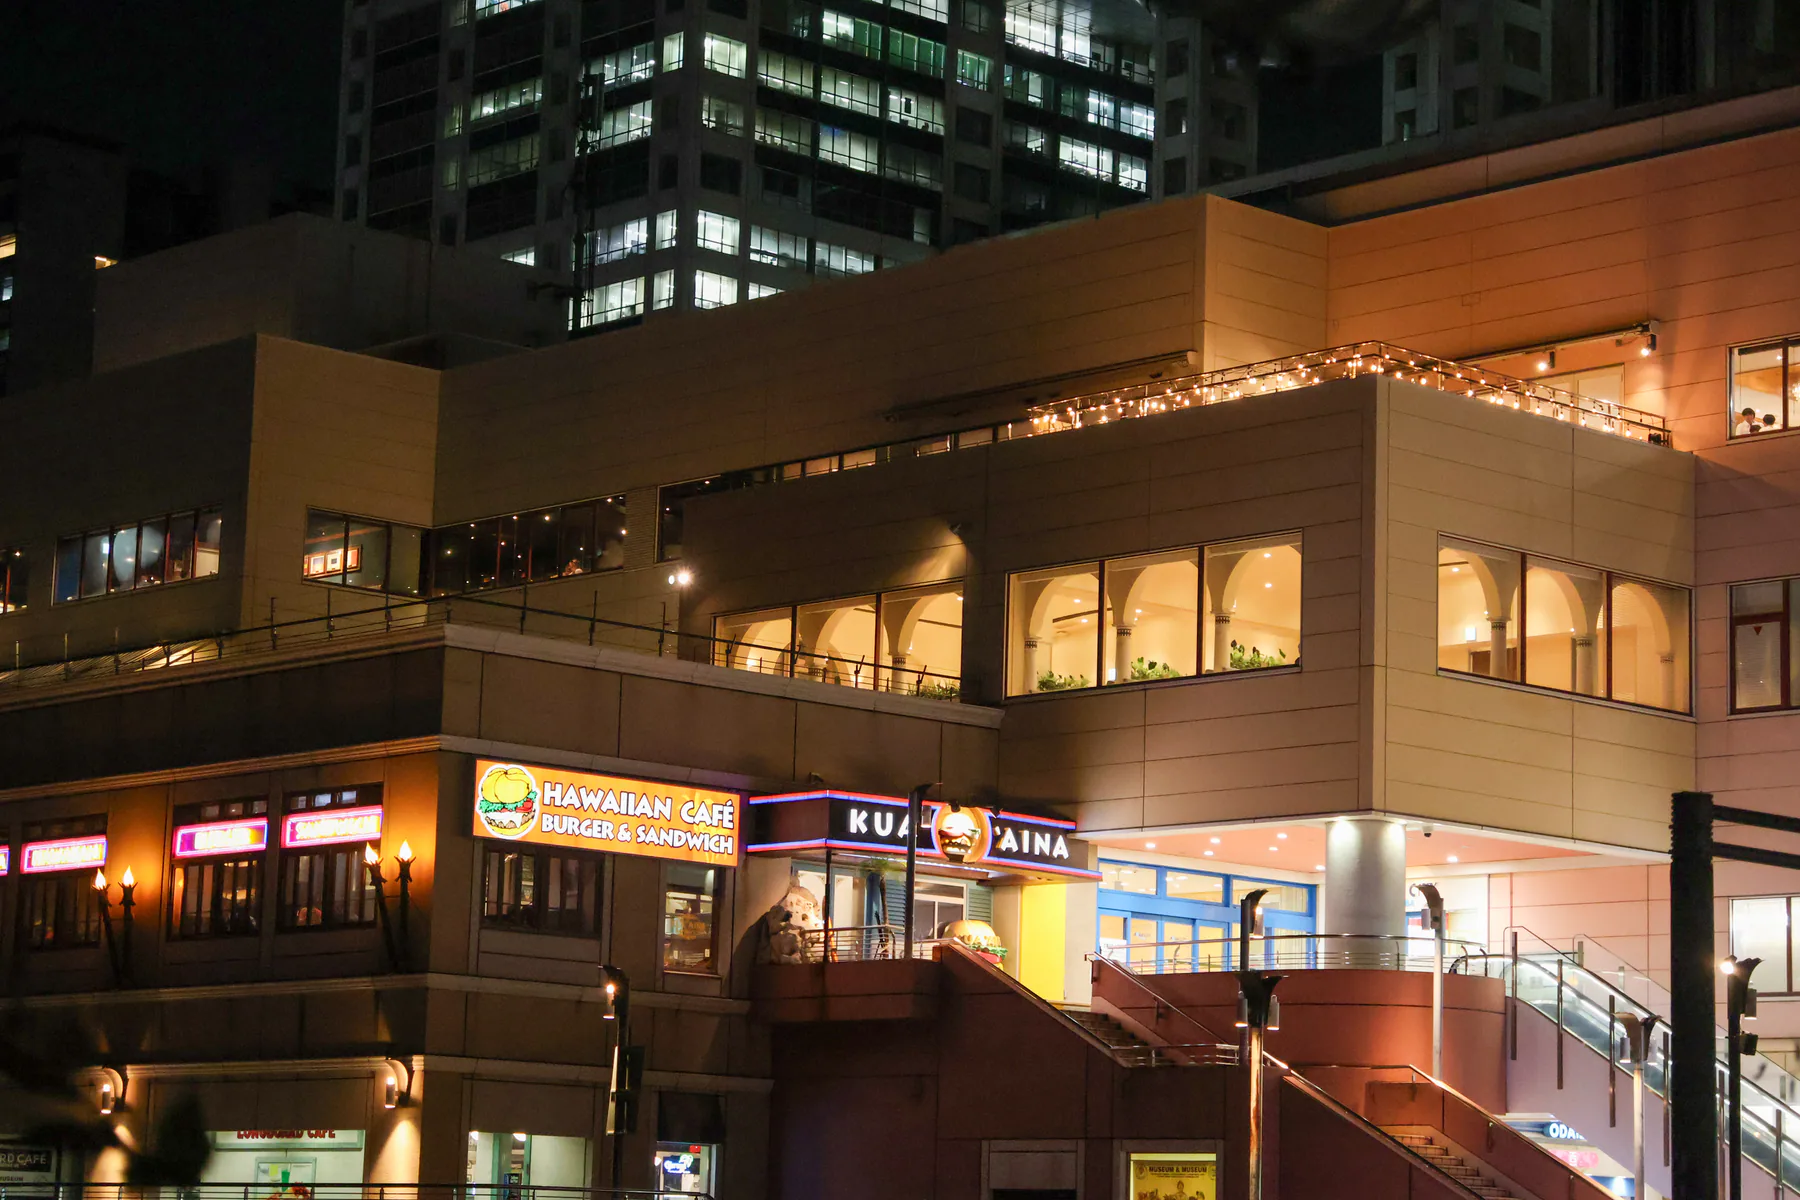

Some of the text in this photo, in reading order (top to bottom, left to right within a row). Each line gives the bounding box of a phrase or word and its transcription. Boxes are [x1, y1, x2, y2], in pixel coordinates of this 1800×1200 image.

[542, 781, 734, 829] HAWAIIAN CAFÉ
[541, 813, 734, 855] BURGER & SANDWICH
[16, 1153, 47, 1165] CAFE
